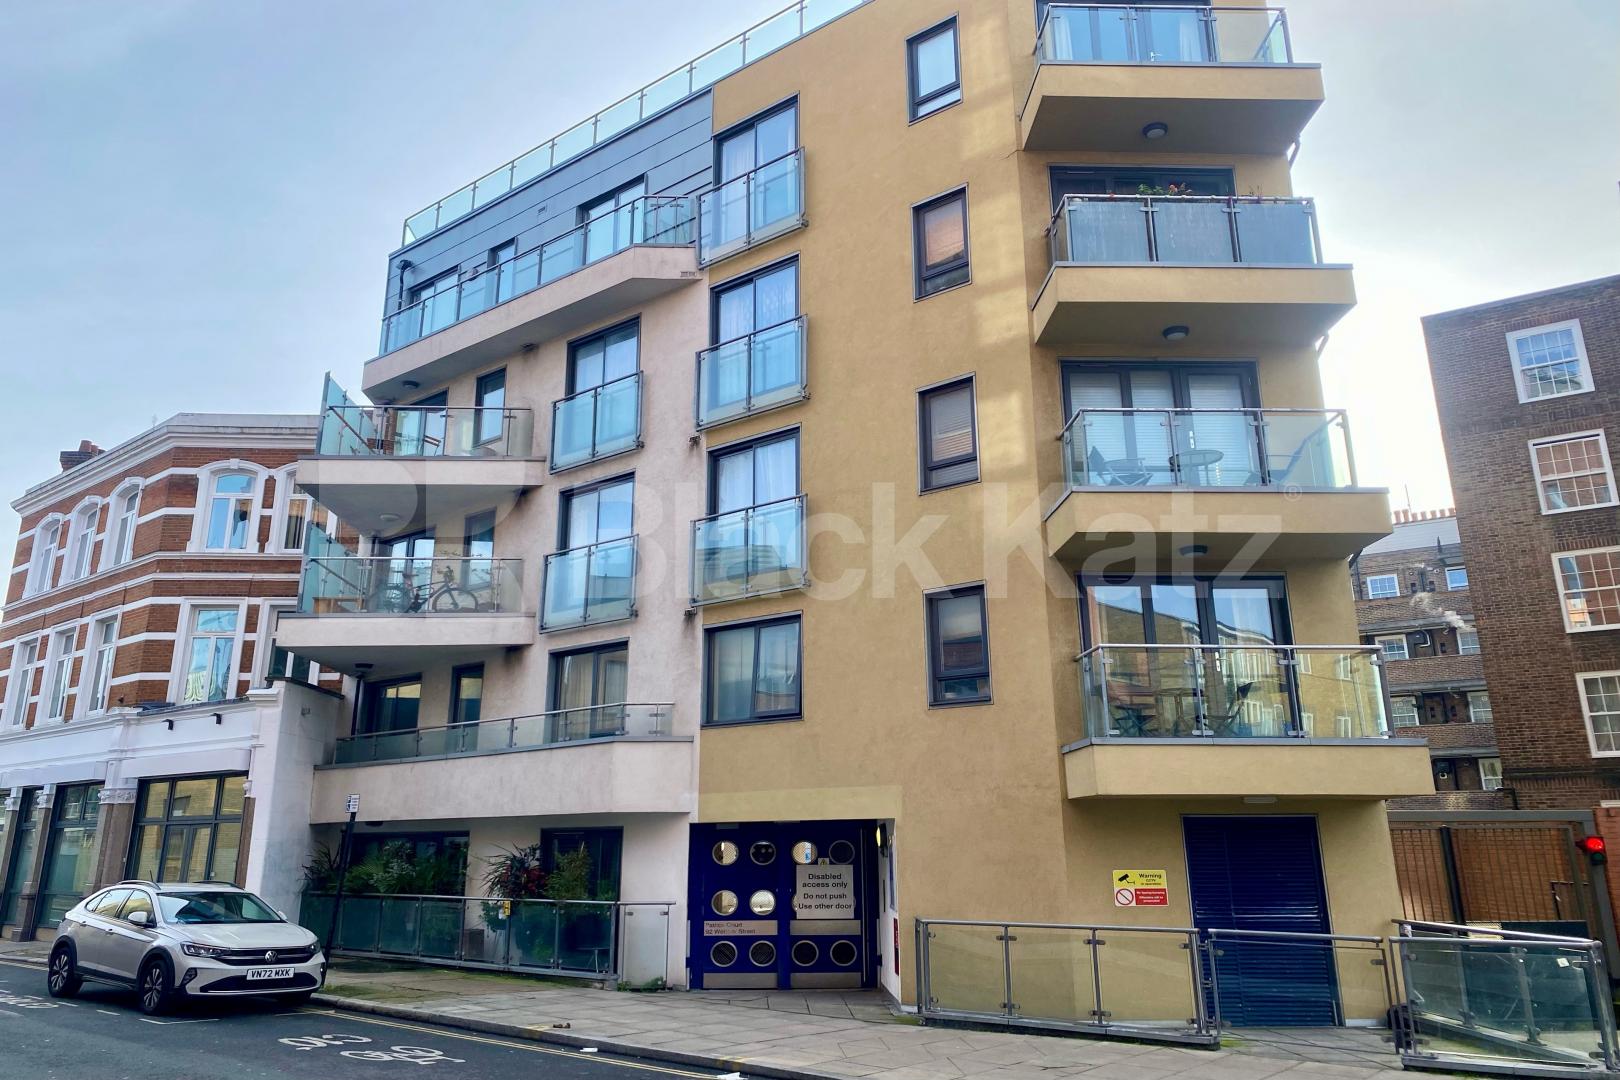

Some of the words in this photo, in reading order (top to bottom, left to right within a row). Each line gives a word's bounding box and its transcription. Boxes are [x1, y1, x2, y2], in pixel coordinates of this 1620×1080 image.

[832, 881, 848, 889] only
[803, 892, 814, 900] Do
[815, 892, 827, 900] not
[829, 892, 847, 901] push
[814, 902, 834, 910] other
[835, 902, 853, 910] door
[251, 969, 273, 979] VN72
[274, 968, 291, 978] MXK
